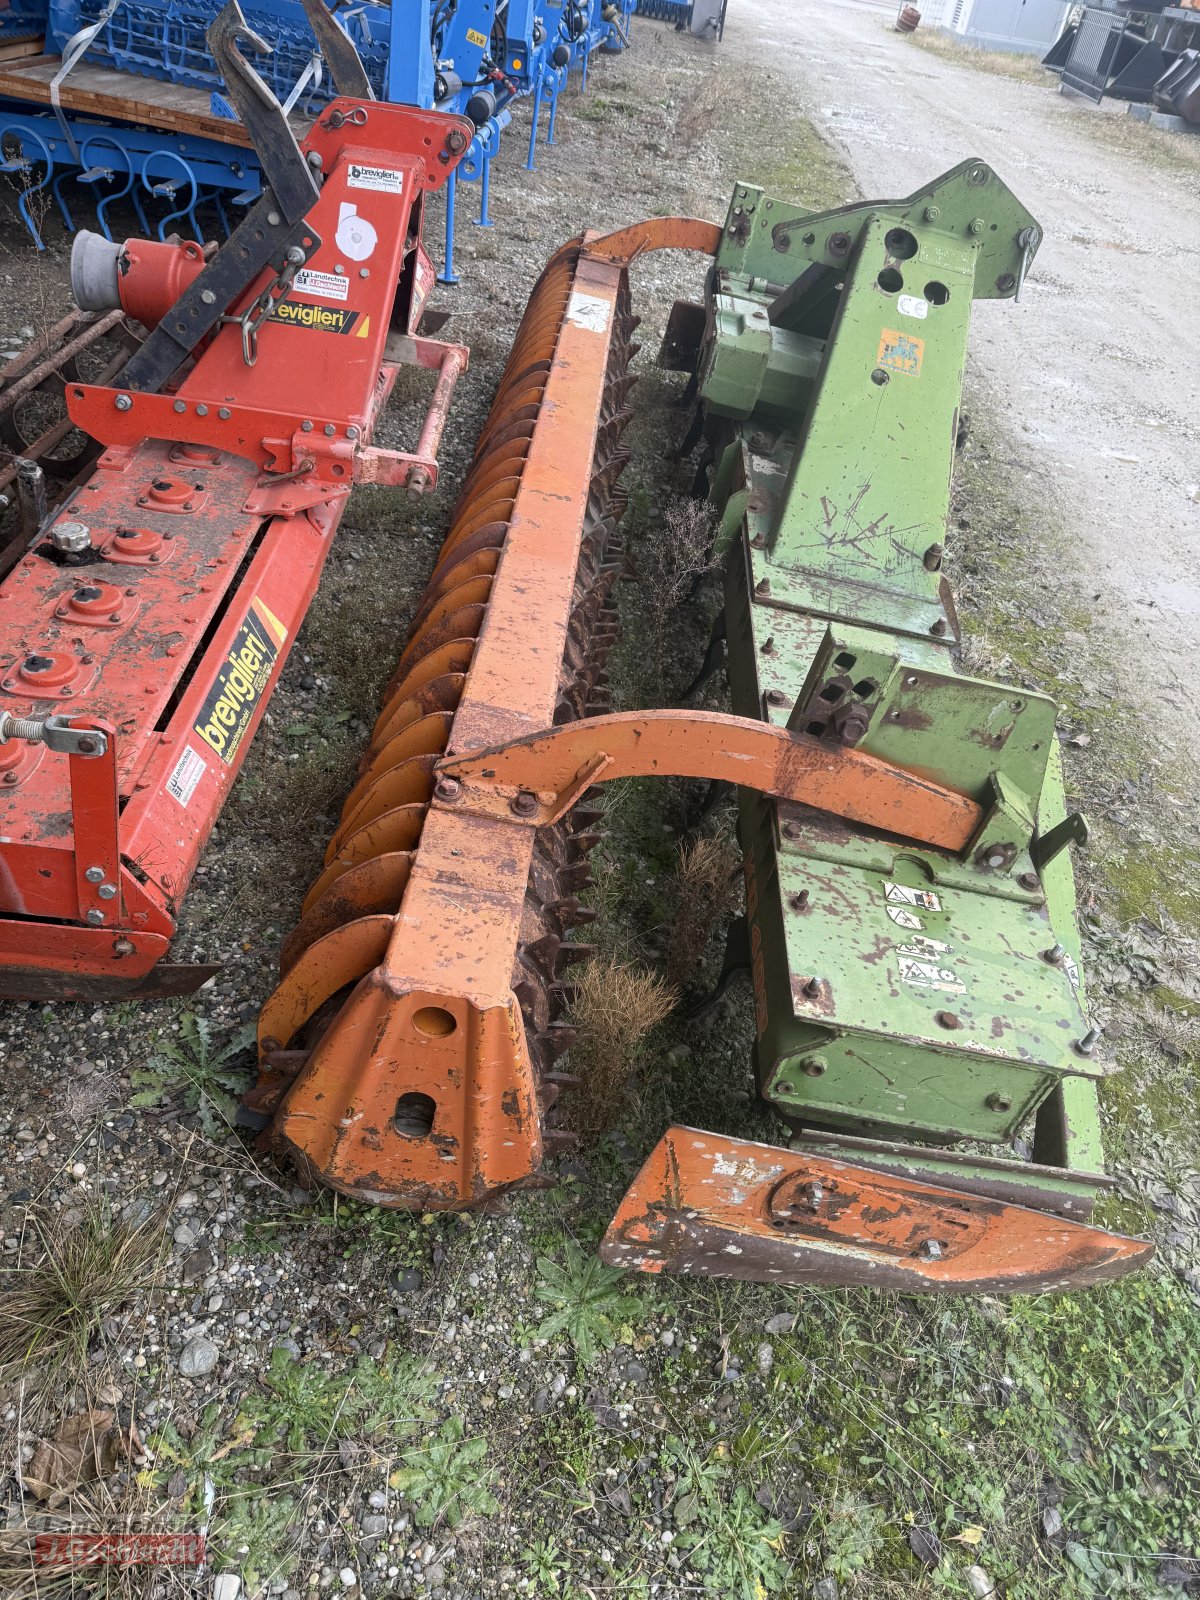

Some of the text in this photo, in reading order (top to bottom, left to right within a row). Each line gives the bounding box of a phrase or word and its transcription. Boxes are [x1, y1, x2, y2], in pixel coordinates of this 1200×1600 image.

[361, 167, 395, 180] breviglieri
[310, 272, 347, 284] Landtechnik
[260, 303, 344, 327] eviglieri
[195, 626, 266, 755] breviglieri
[175, 749, 192, 779] Landtechnik
